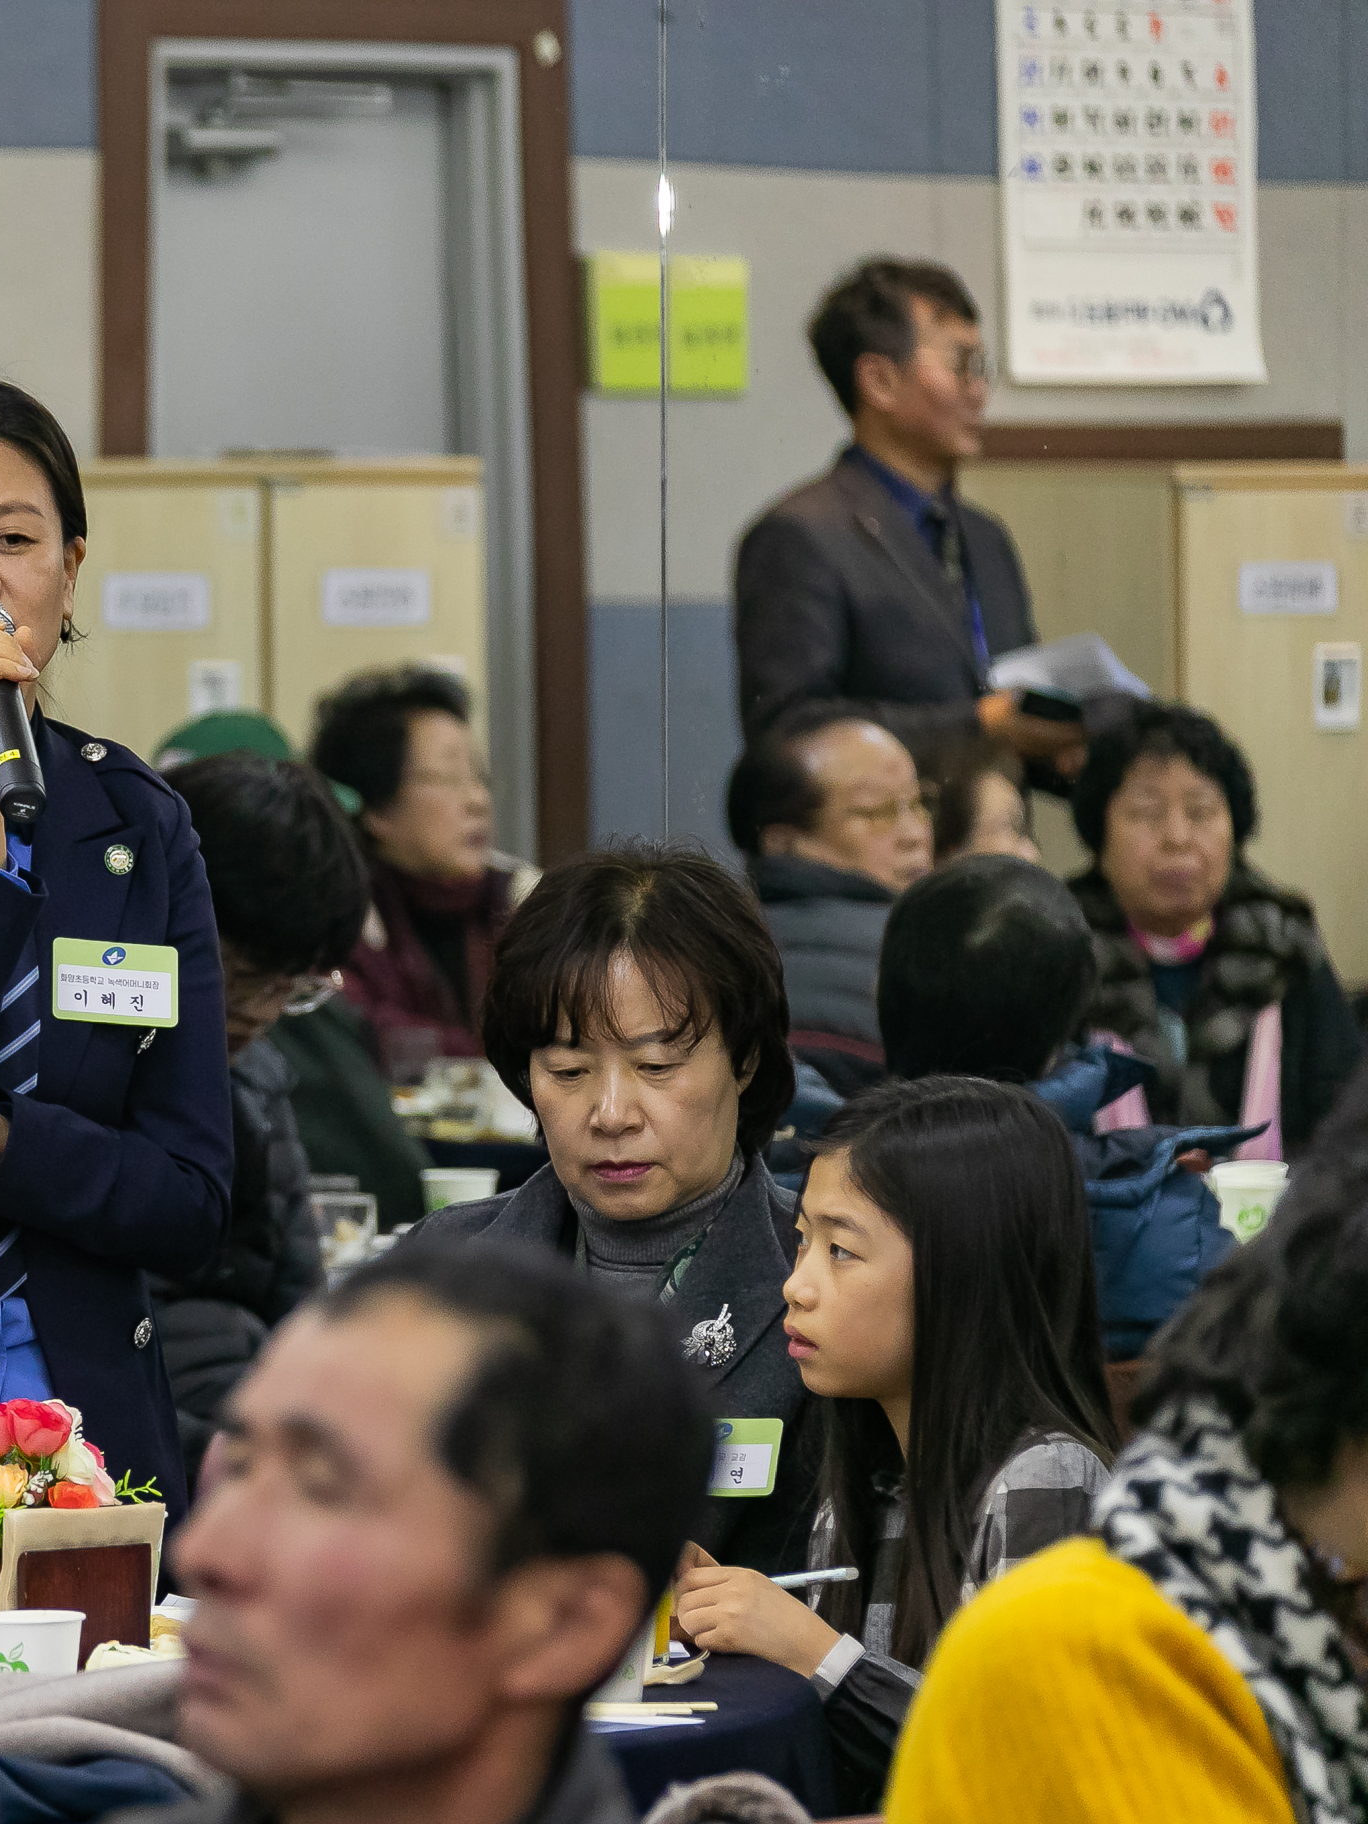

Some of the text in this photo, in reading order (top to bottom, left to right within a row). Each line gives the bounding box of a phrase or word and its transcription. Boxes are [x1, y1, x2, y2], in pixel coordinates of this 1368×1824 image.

[60, 973, 160, 990] 화양초등학교 녹색어머니회장
[730, 1466, 744, 1485] 연
